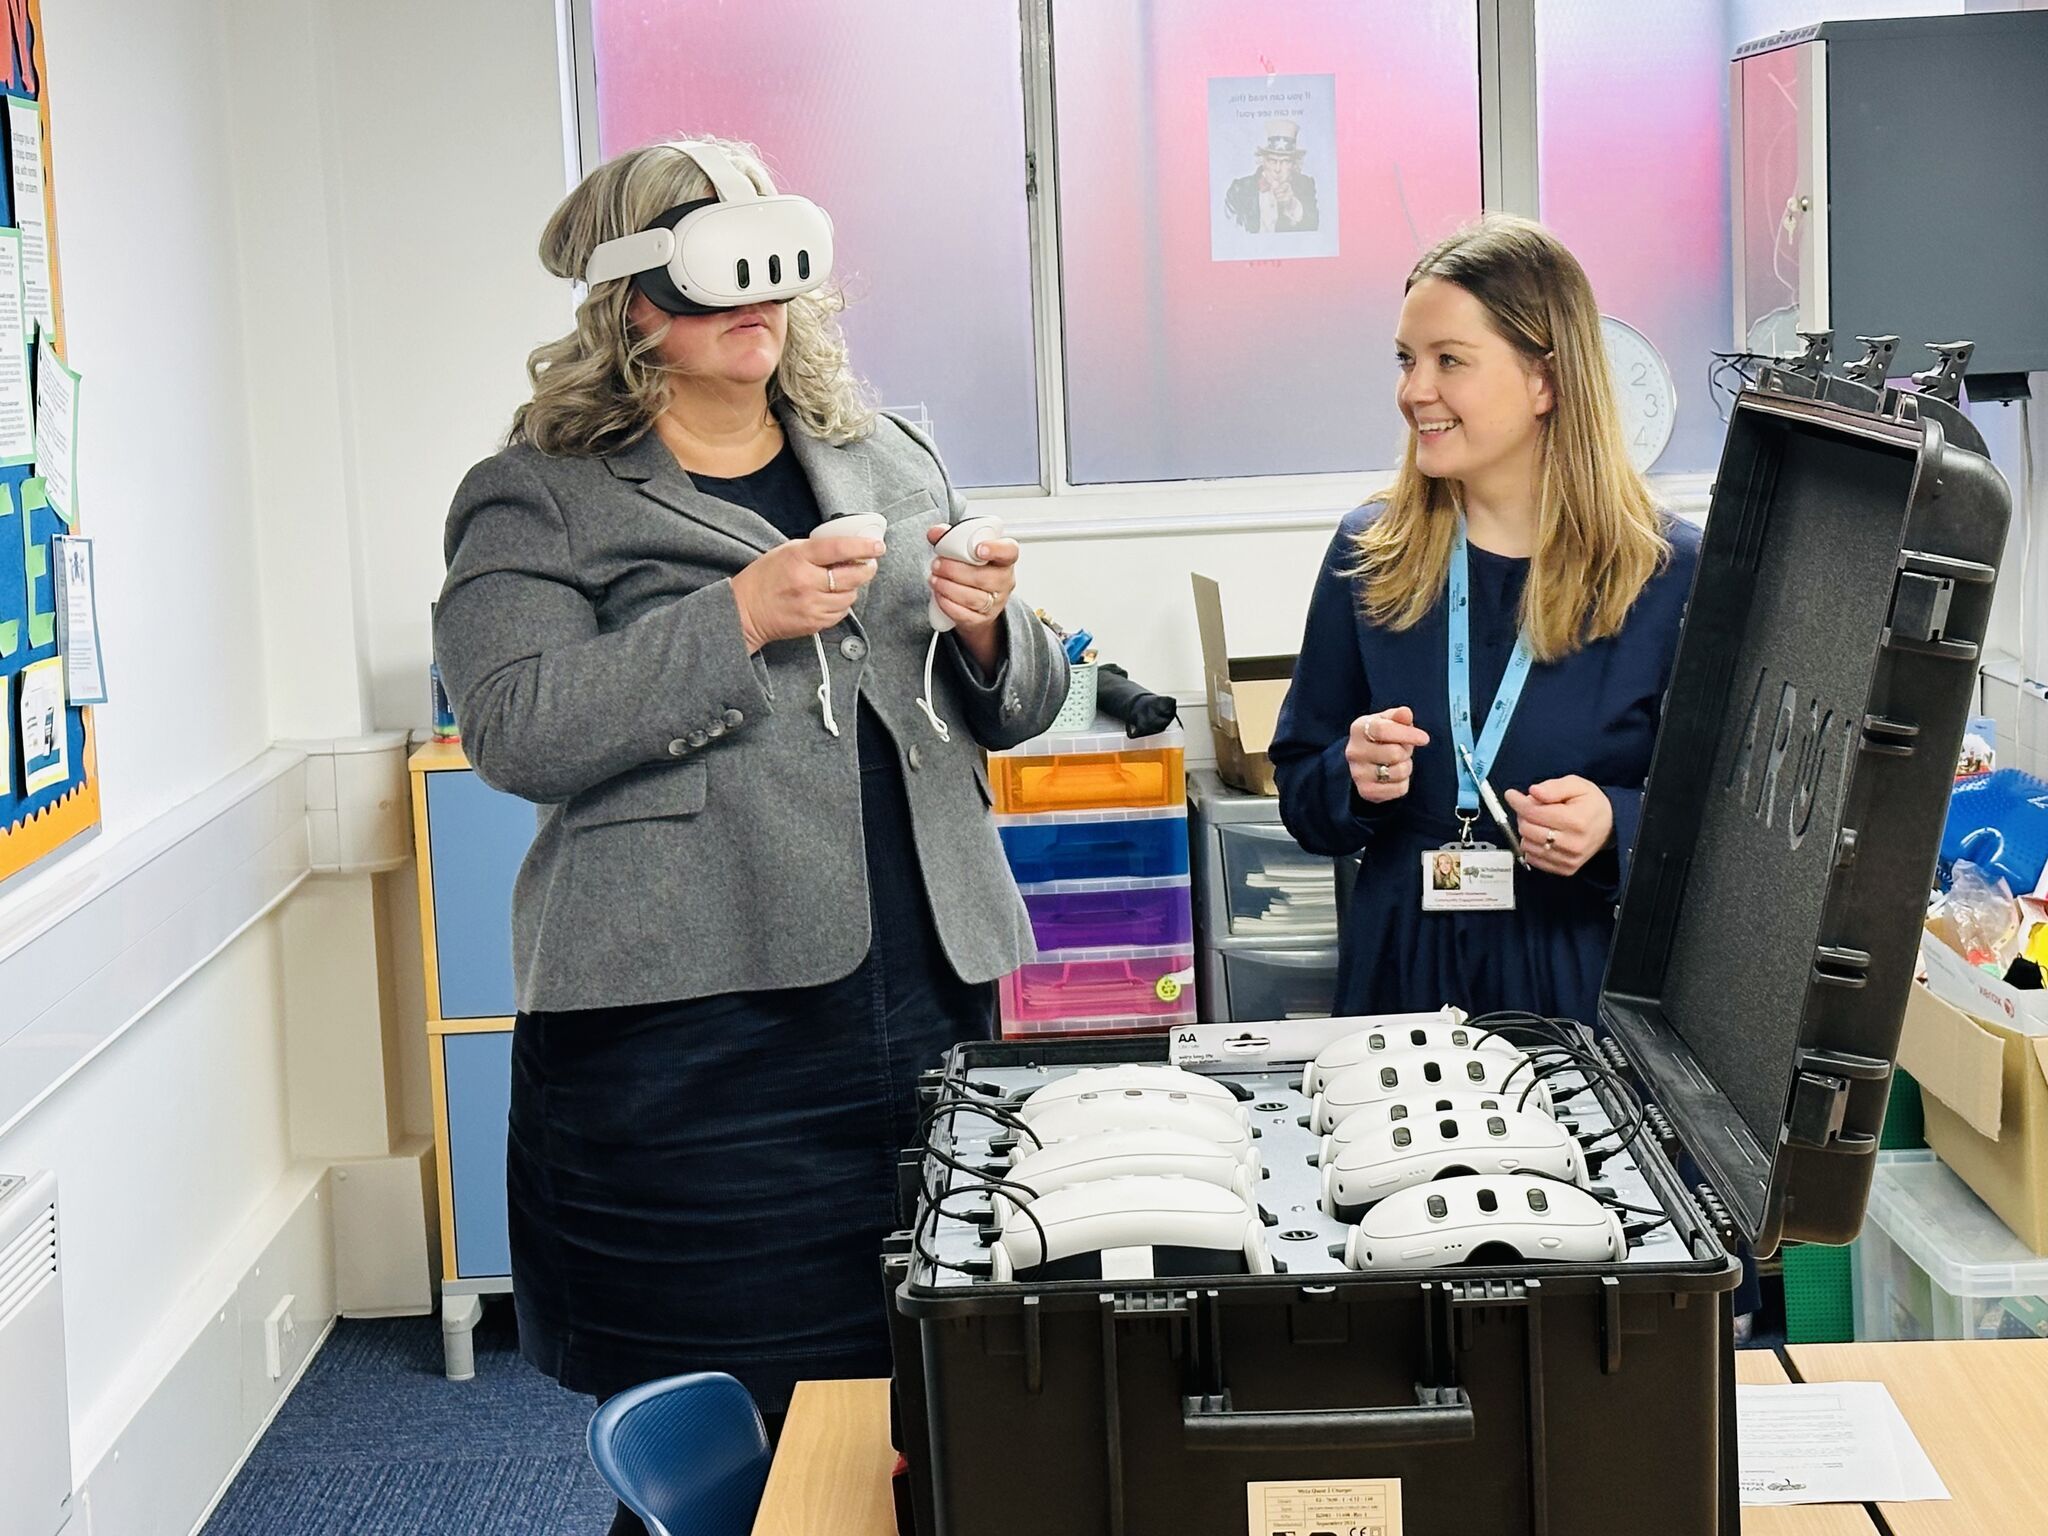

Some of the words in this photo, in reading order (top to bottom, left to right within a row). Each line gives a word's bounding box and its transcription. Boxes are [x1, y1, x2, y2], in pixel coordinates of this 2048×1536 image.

[1630, 362, 1648, 386] 2
[1643, 393, 1659, 418] 3
[1633, 426, 1649, 446] 4
[1454, 642, 1465, 665] Staff
[1178, 1033, 1197, 1043] AA
